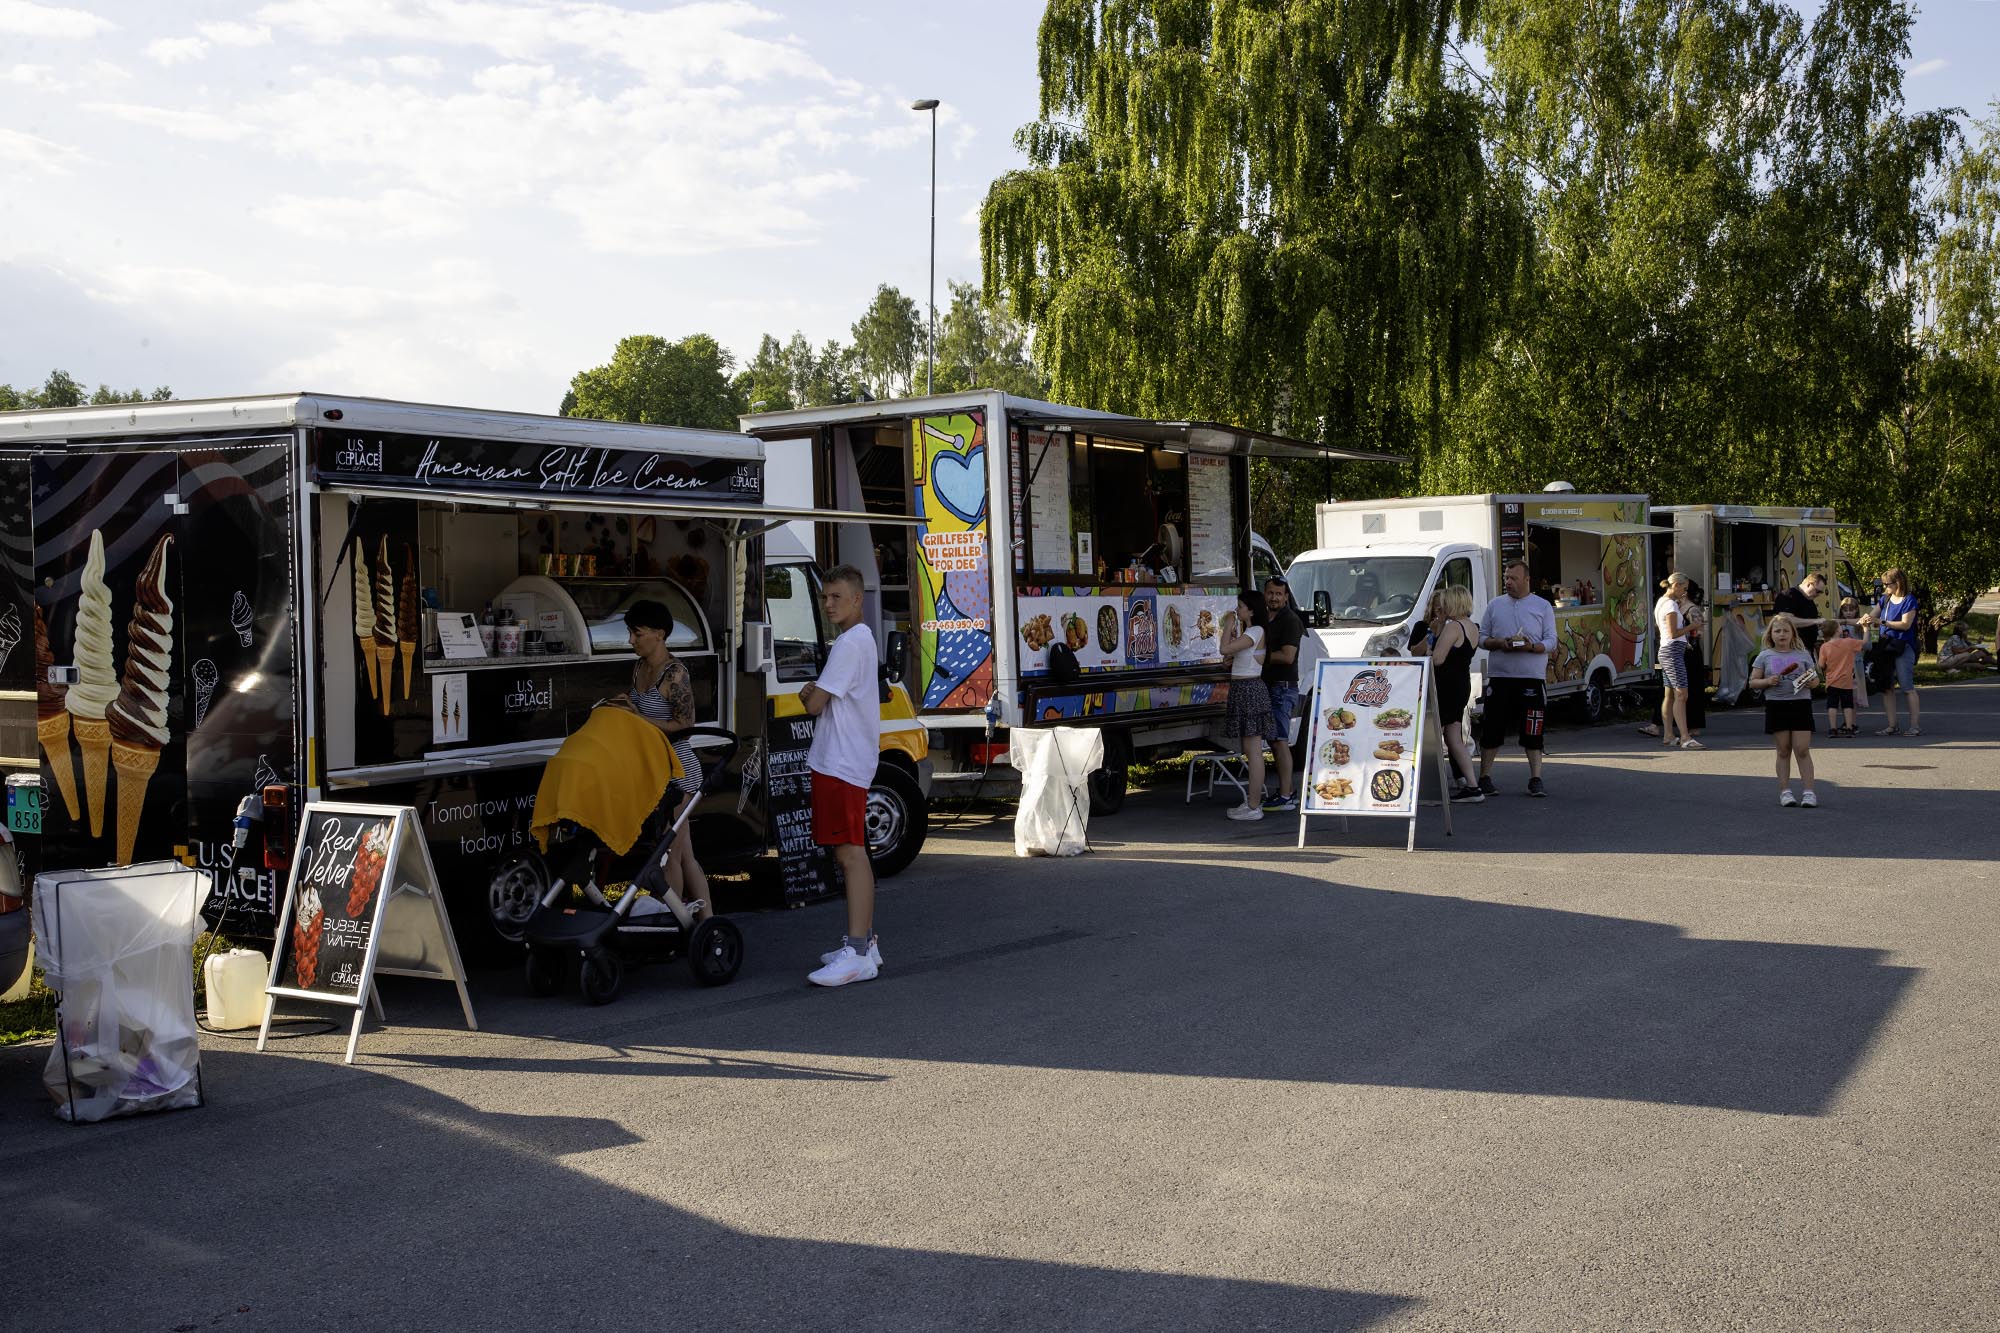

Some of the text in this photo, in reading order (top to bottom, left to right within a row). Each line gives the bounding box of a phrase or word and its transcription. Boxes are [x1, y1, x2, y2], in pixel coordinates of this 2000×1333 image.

[415, 440, 708, 491] American Soft Ice Cream
[924, 533, 975, 546] GRILLFEST
[928, 546, 981, 558] VI GRILLER
[935, 559, 953, 571] FOR
[938, 620, 955, 630] 463
[956, 619, 972, 630] 950
[973, 619, 985, 629] 49
[1343, 677, 1393, 705] Food
[769, 751, 810, 765] AMERIKANS
[428, 795, 537, 825] Tomorrow we
[792, 808, 813, 823] VELV
[319, 817, 364, 854] Red
[460, 827, 506, 855] today
[512, 831, 523, 846] is
[199, 842, 233, 869] U.S
[302, 845, 358, 889] Velvet
[323, 918, 370, 934] BUBBLE
[327, 933, 370, 950] WAFFLE
